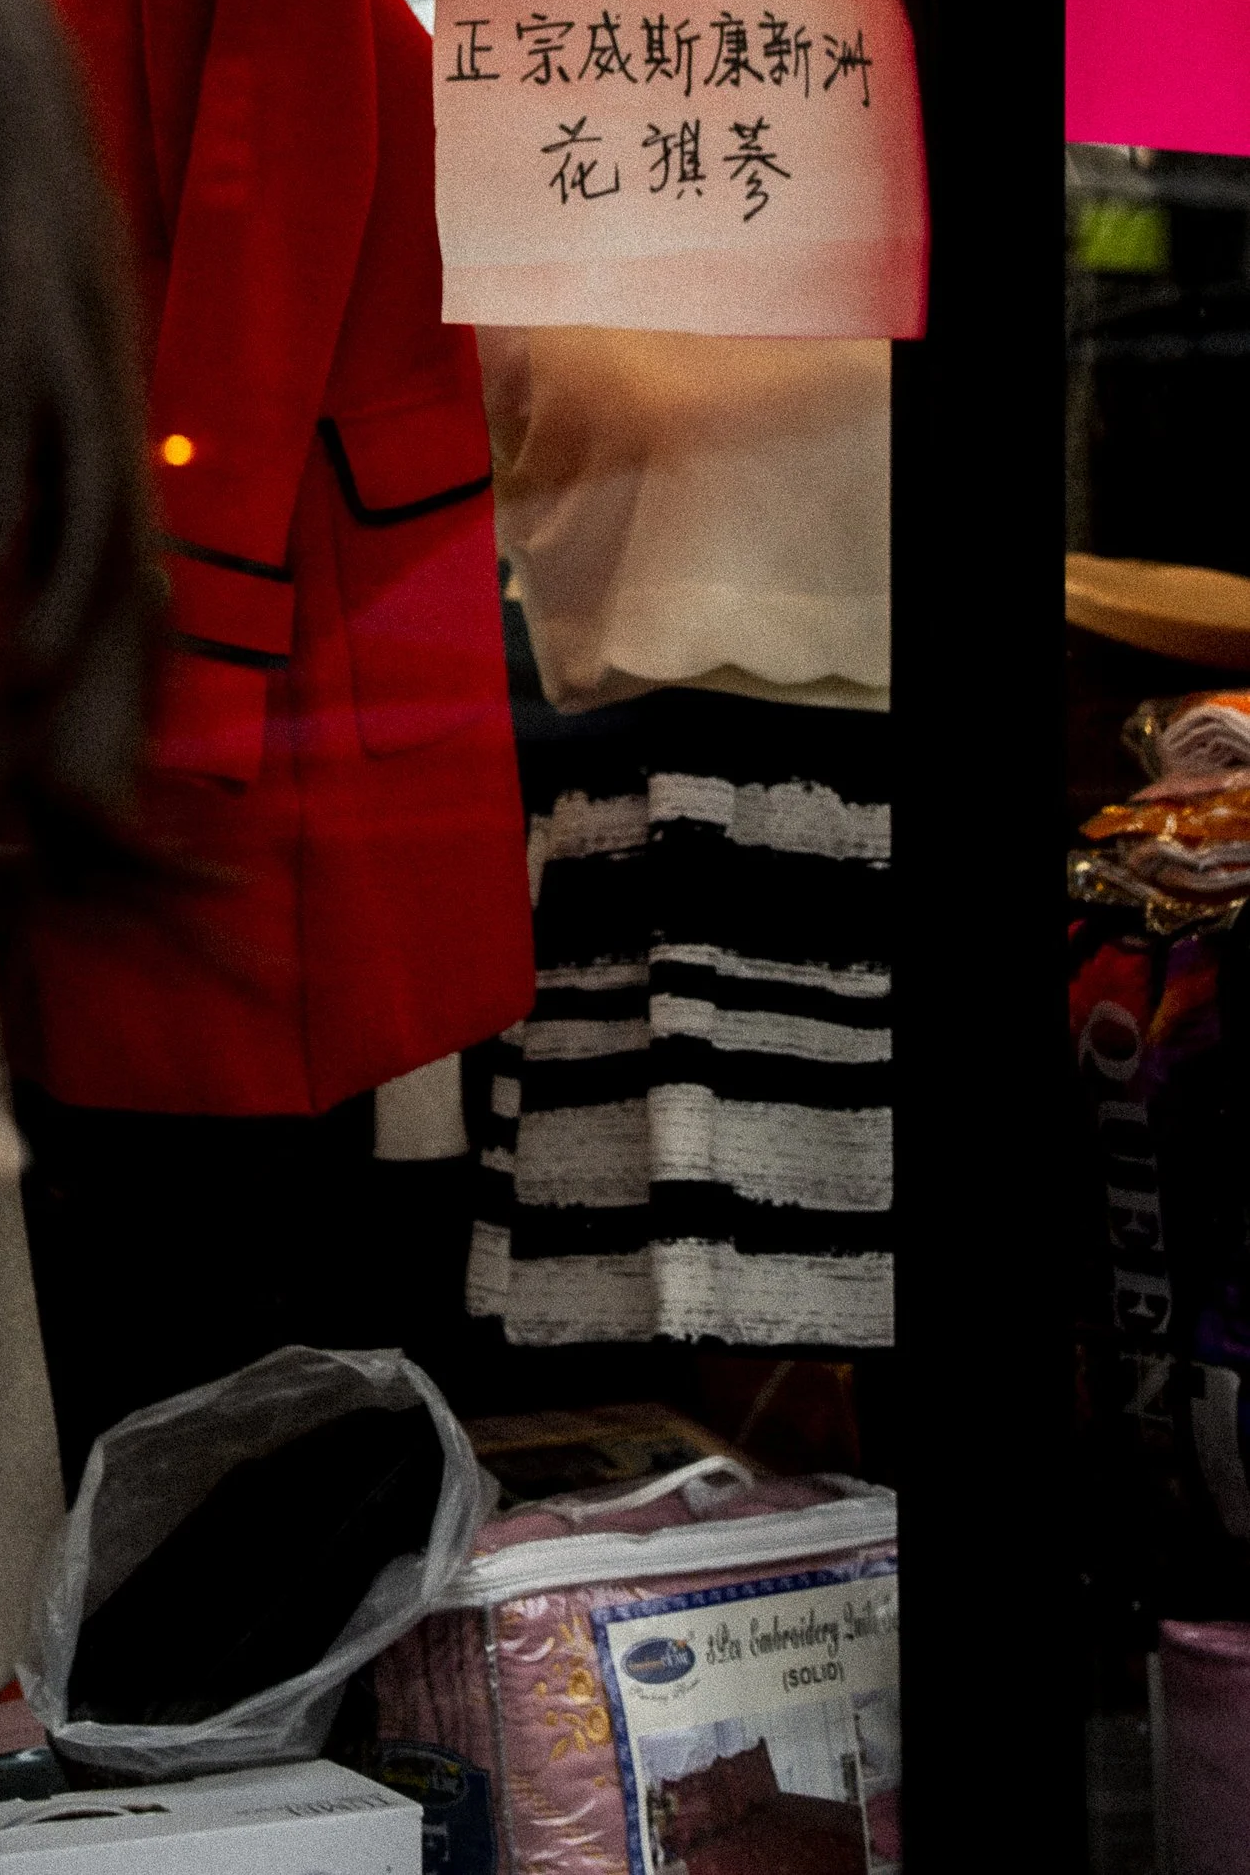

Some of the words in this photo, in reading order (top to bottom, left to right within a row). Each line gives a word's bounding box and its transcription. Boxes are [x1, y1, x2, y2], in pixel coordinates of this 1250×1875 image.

[446, 10, 872, 108] 正宗威斯康新洲
[782, 1662, 844, 1693] (SOLID)
